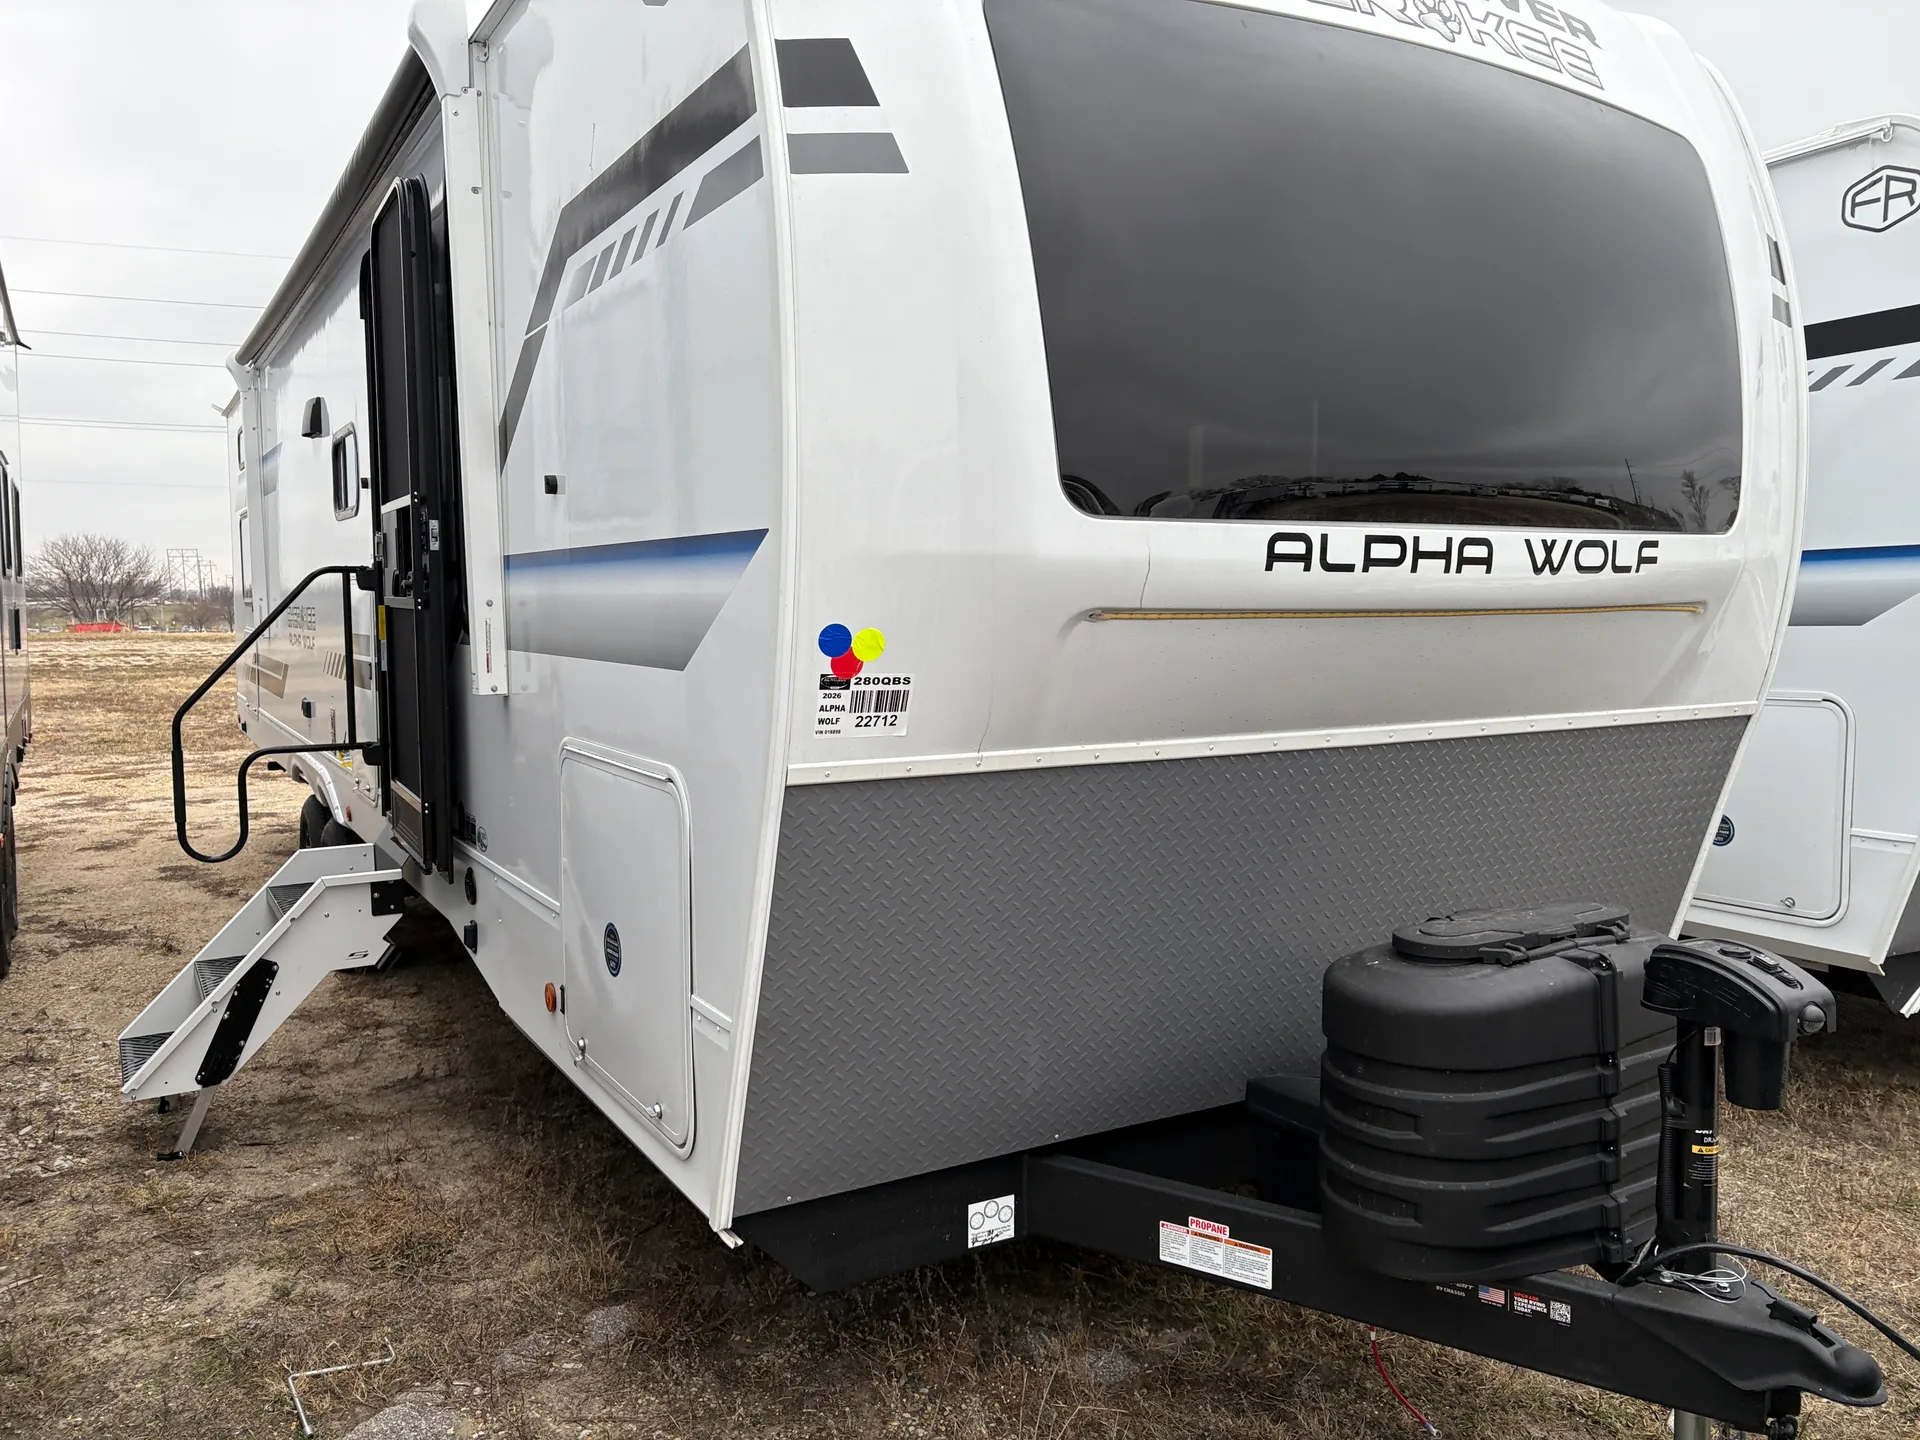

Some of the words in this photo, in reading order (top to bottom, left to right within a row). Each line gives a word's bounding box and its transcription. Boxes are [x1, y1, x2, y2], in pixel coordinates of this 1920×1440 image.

[1264, 532, 1494, 575] ALPHA
[1524, 538, 1660, 576] WOLF
[854, 677, 911, 686] 280QBS
[855, 715, 898, 727] 22712
[1190, 1218, 1228, 1236] PROPANE
[1443, 1287, 1466, 1297] CHASSIS
[1513, 1296, 1529, 1304] YOUR
[1513, 1300, 1548, 1314] EXPERIENCE
[1513, 1306, 1533, 1314] TODAY.
